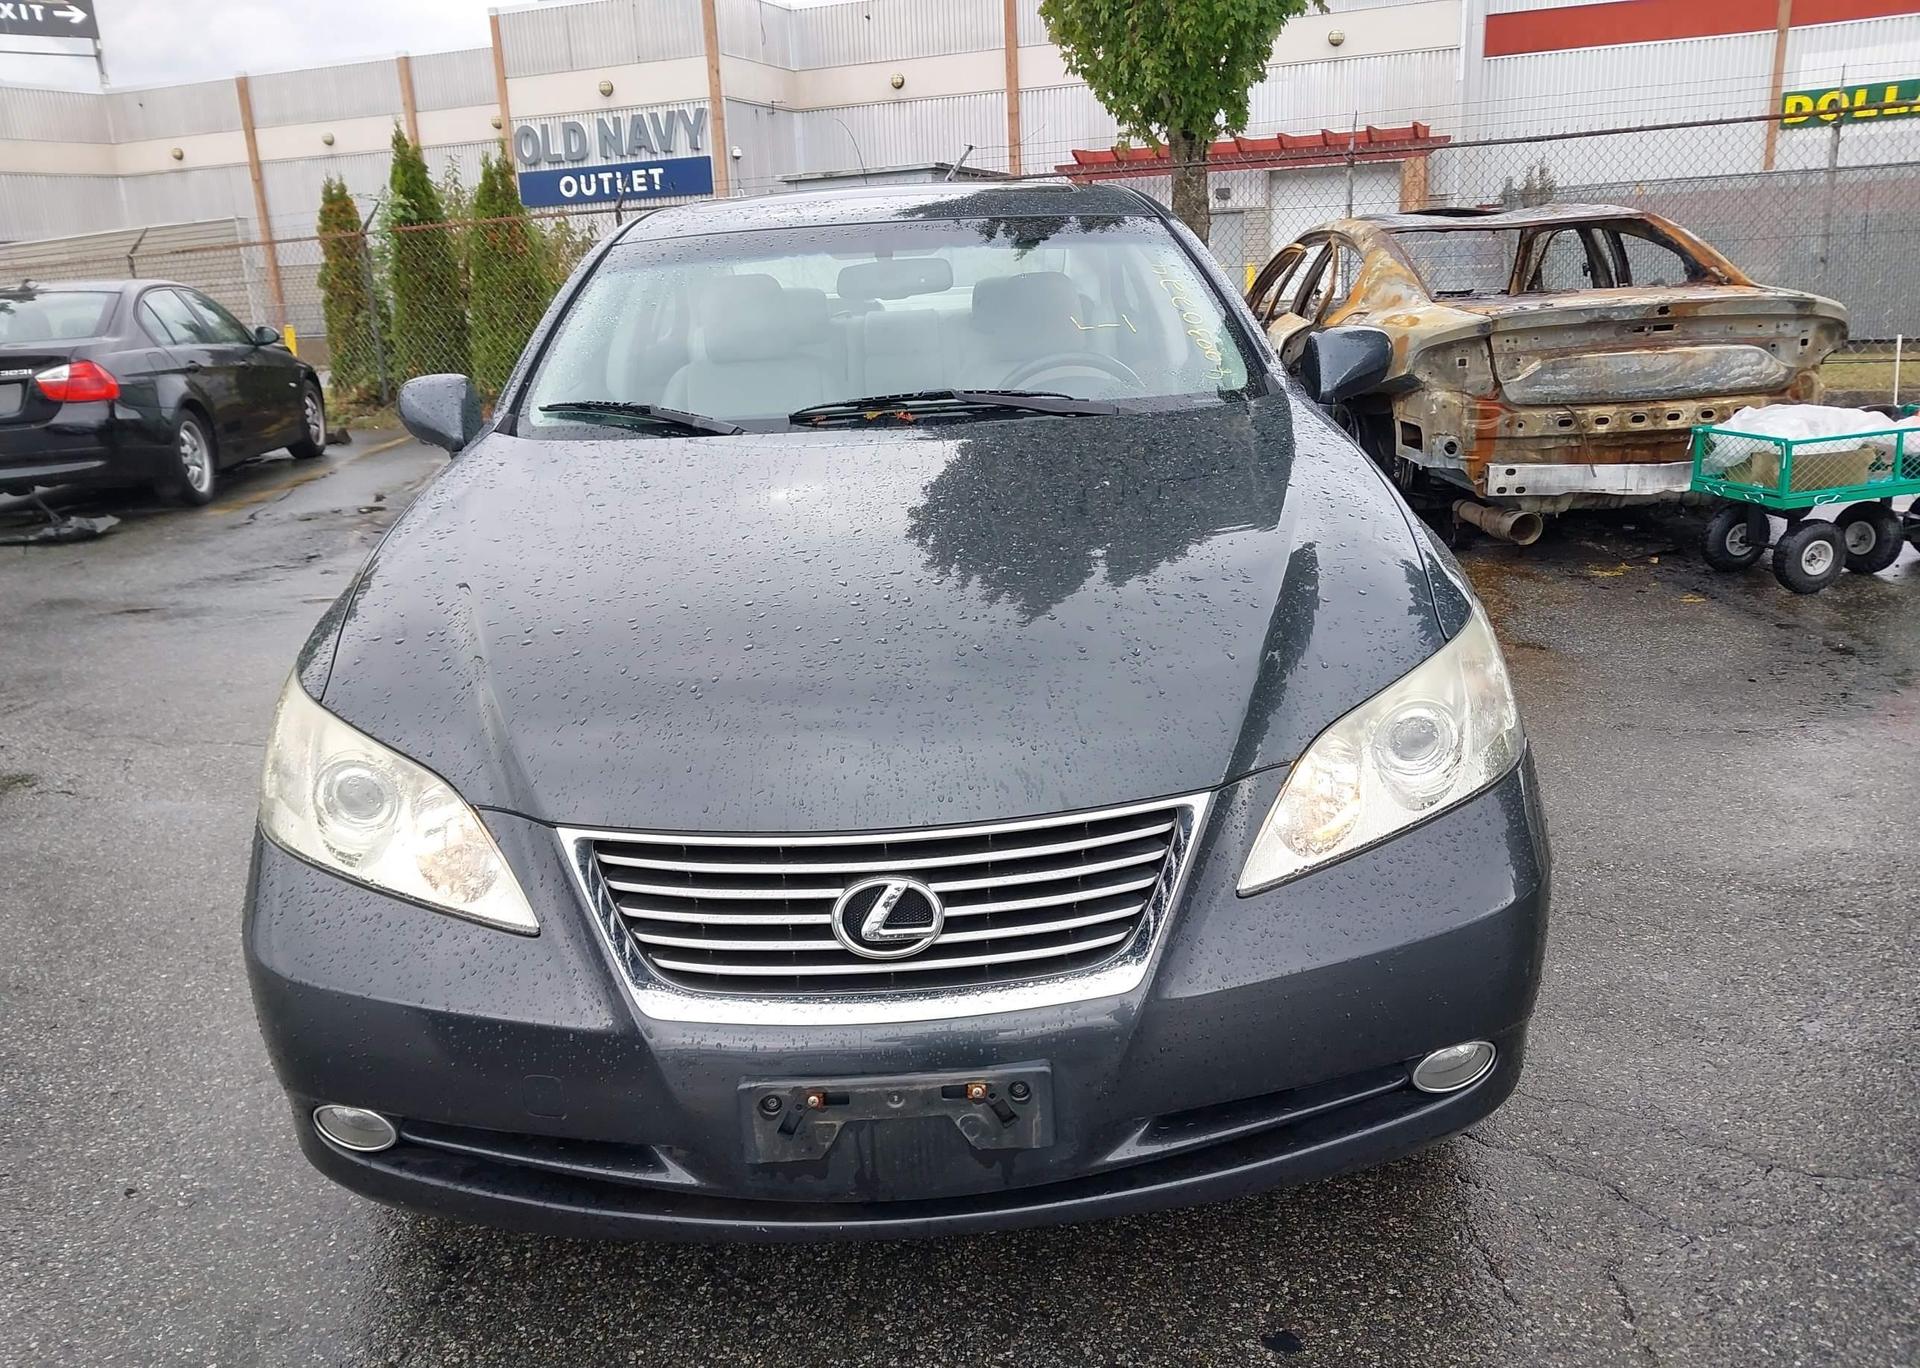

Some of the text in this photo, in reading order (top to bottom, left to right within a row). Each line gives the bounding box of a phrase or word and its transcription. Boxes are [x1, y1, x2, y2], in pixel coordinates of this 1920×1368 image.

[1783, 85, 1920, 124] DOLL
[514, 107, 707, 166] OLD NAVY
[558, 167, 664, 198] OUTLET
